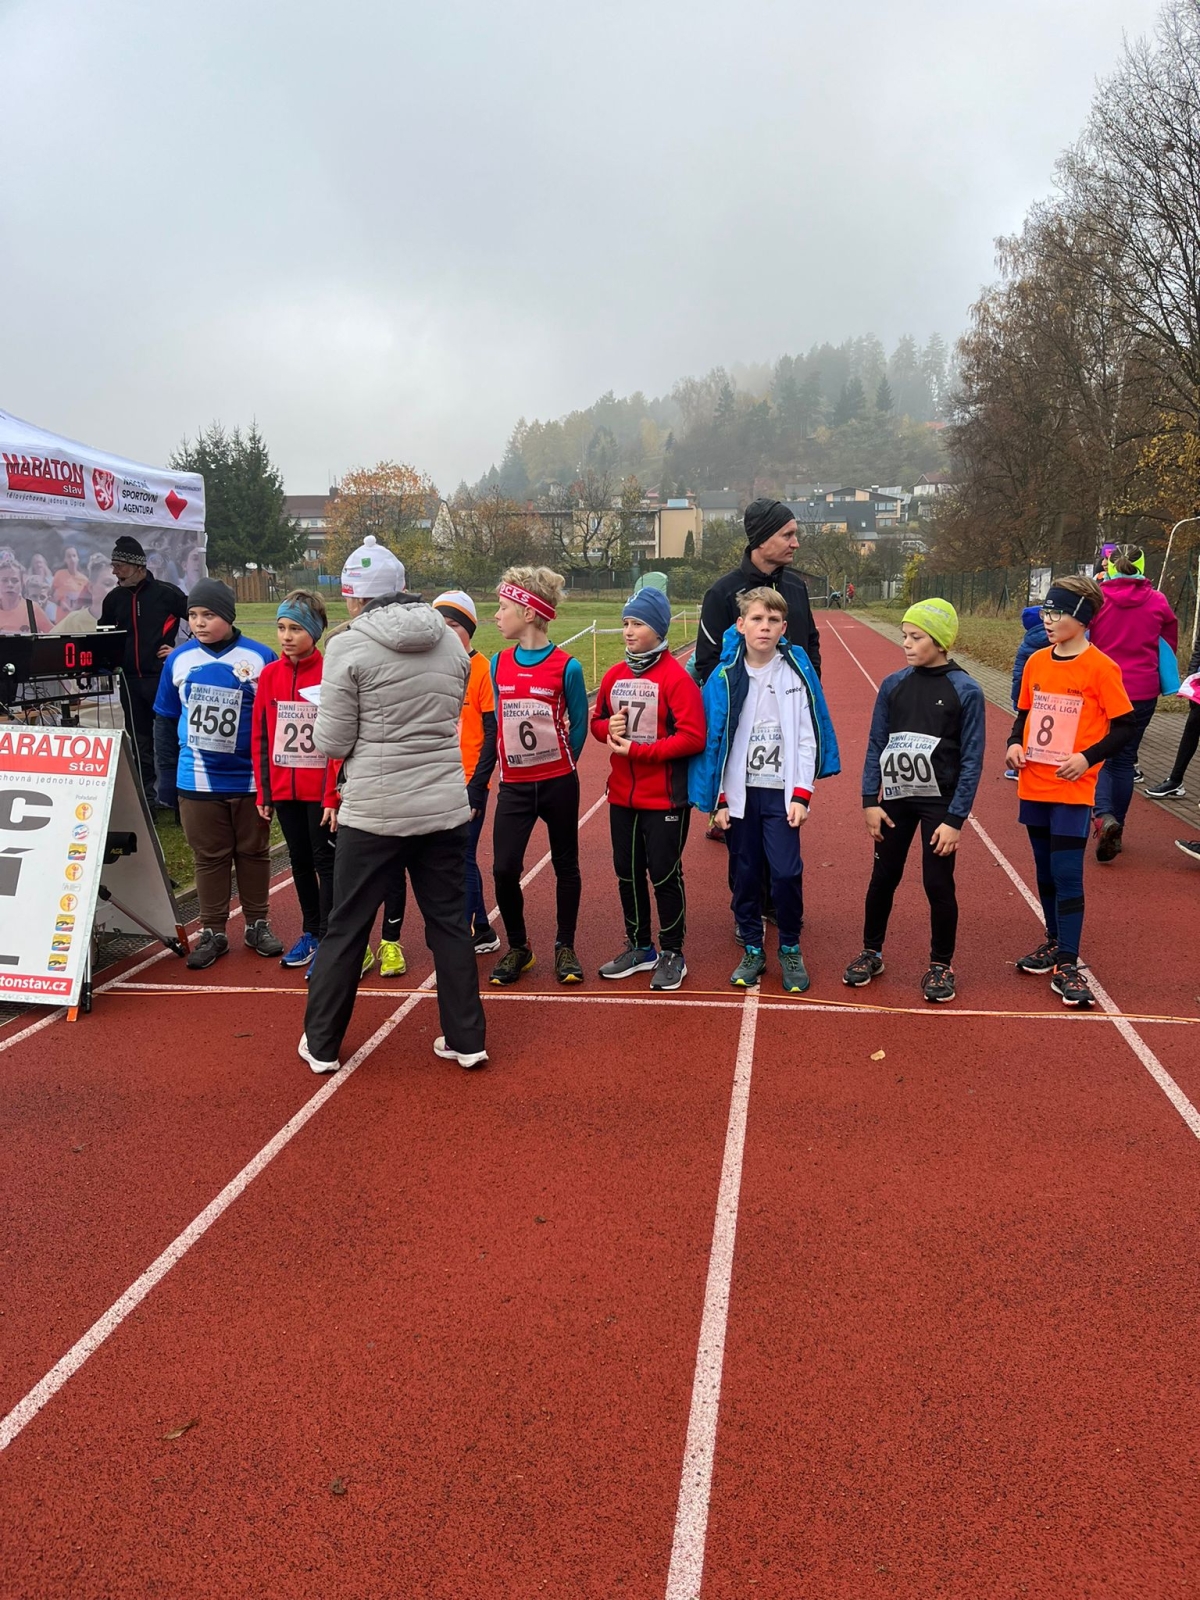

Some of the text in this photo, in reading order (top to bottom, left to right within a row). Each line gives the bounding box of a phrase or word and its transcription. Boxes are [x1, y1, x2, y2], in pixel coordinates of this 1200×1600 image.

[2, 453, 84, 484] MARATON
[63, 485, 82, 494] stav
[122, 489, 158, 503] SPORTOVNÍ
[122, 503, 154, 515] AGENTURA
[222, 698, 239, 706] LIGA
[1060, 706, 1078, 714] LIGA
[190, 704, 237, 737] 458
[284, 723, 316, 753] 23
[519, 721, 537, 750] 6
[1036, 715, 1054, 746] 8
[69, 761, 104, 772] stav
[884, 752, 931, 783] 490
[36, 777, 73, 785] jednota
[78, 777, 107, 787] Úpice
[0, 975, 68, 991] tonstav.cz
